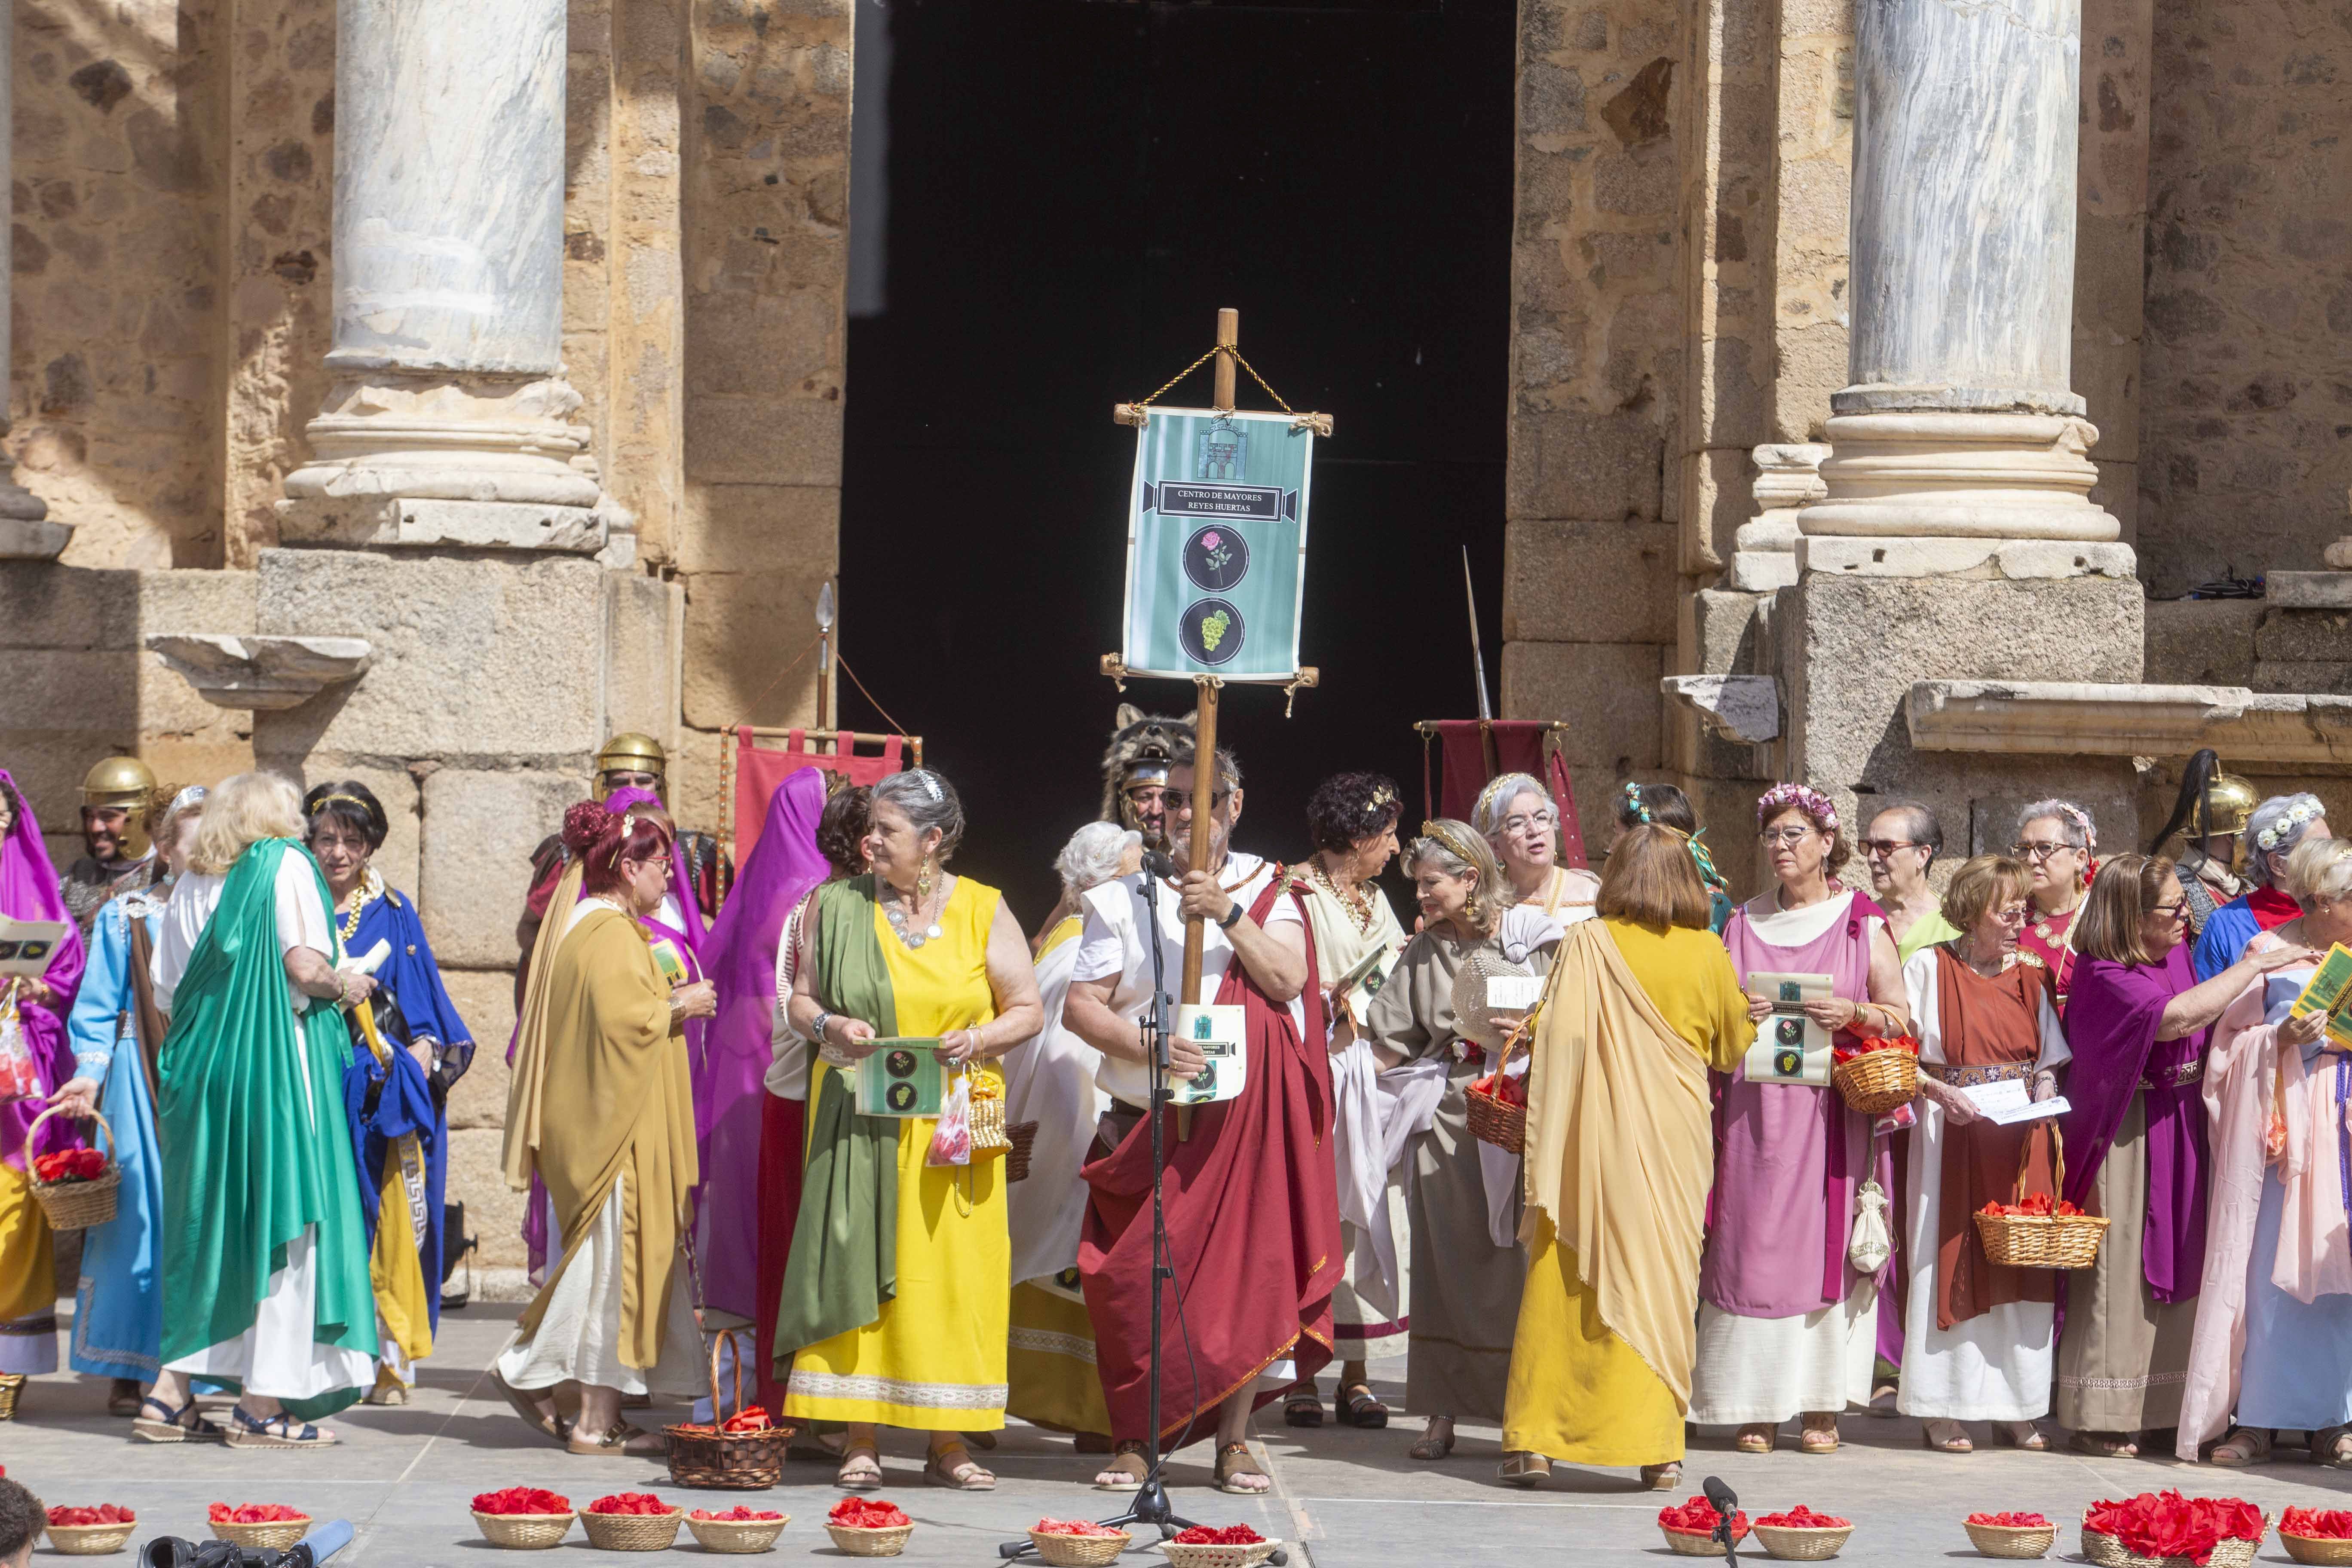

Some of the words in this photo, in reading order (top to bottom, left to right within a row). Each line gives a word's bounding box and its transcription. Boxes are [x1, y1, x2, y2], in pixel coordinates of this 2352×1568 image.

[1178, 490, 1210, 499] CENTRO
[1224, 493, 1262, 501] MAYORES
[1188, 502, 1213, 510] REYES
[1215, 503, 1250, 512] HUERTAS
